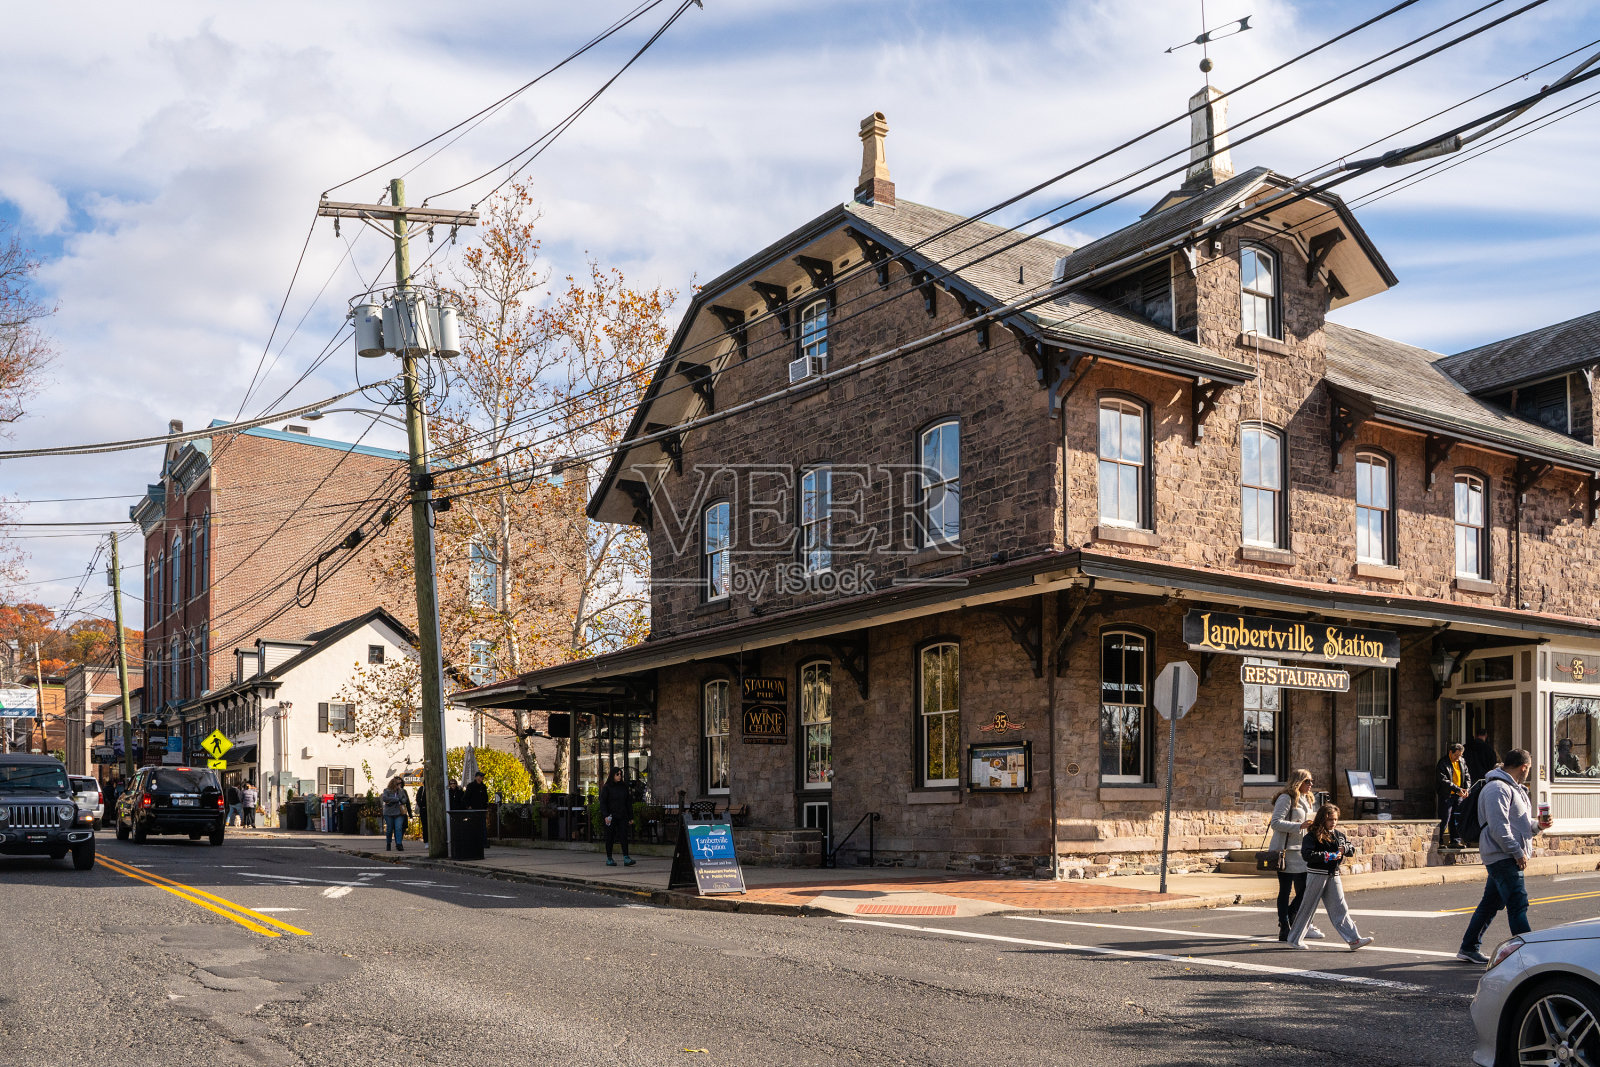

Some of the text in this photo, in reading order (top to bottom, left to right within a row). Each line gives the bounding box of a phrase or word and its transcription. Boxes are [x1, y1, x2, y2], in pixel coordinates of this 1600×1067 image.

[1200, 613, 1387, 663] Lambertville Station
[1573, 659, 1584, 675] 35
[1244, 666, 1347, 688] RESTAURANT
[744, 679, 785, 697] STATION
[749, 712, 782, 725] WINE
[994, 714, 1006, 728] 35
[749, 723, 782, 734] CELLAR
[695, 837, 728, 850] Lambertville
